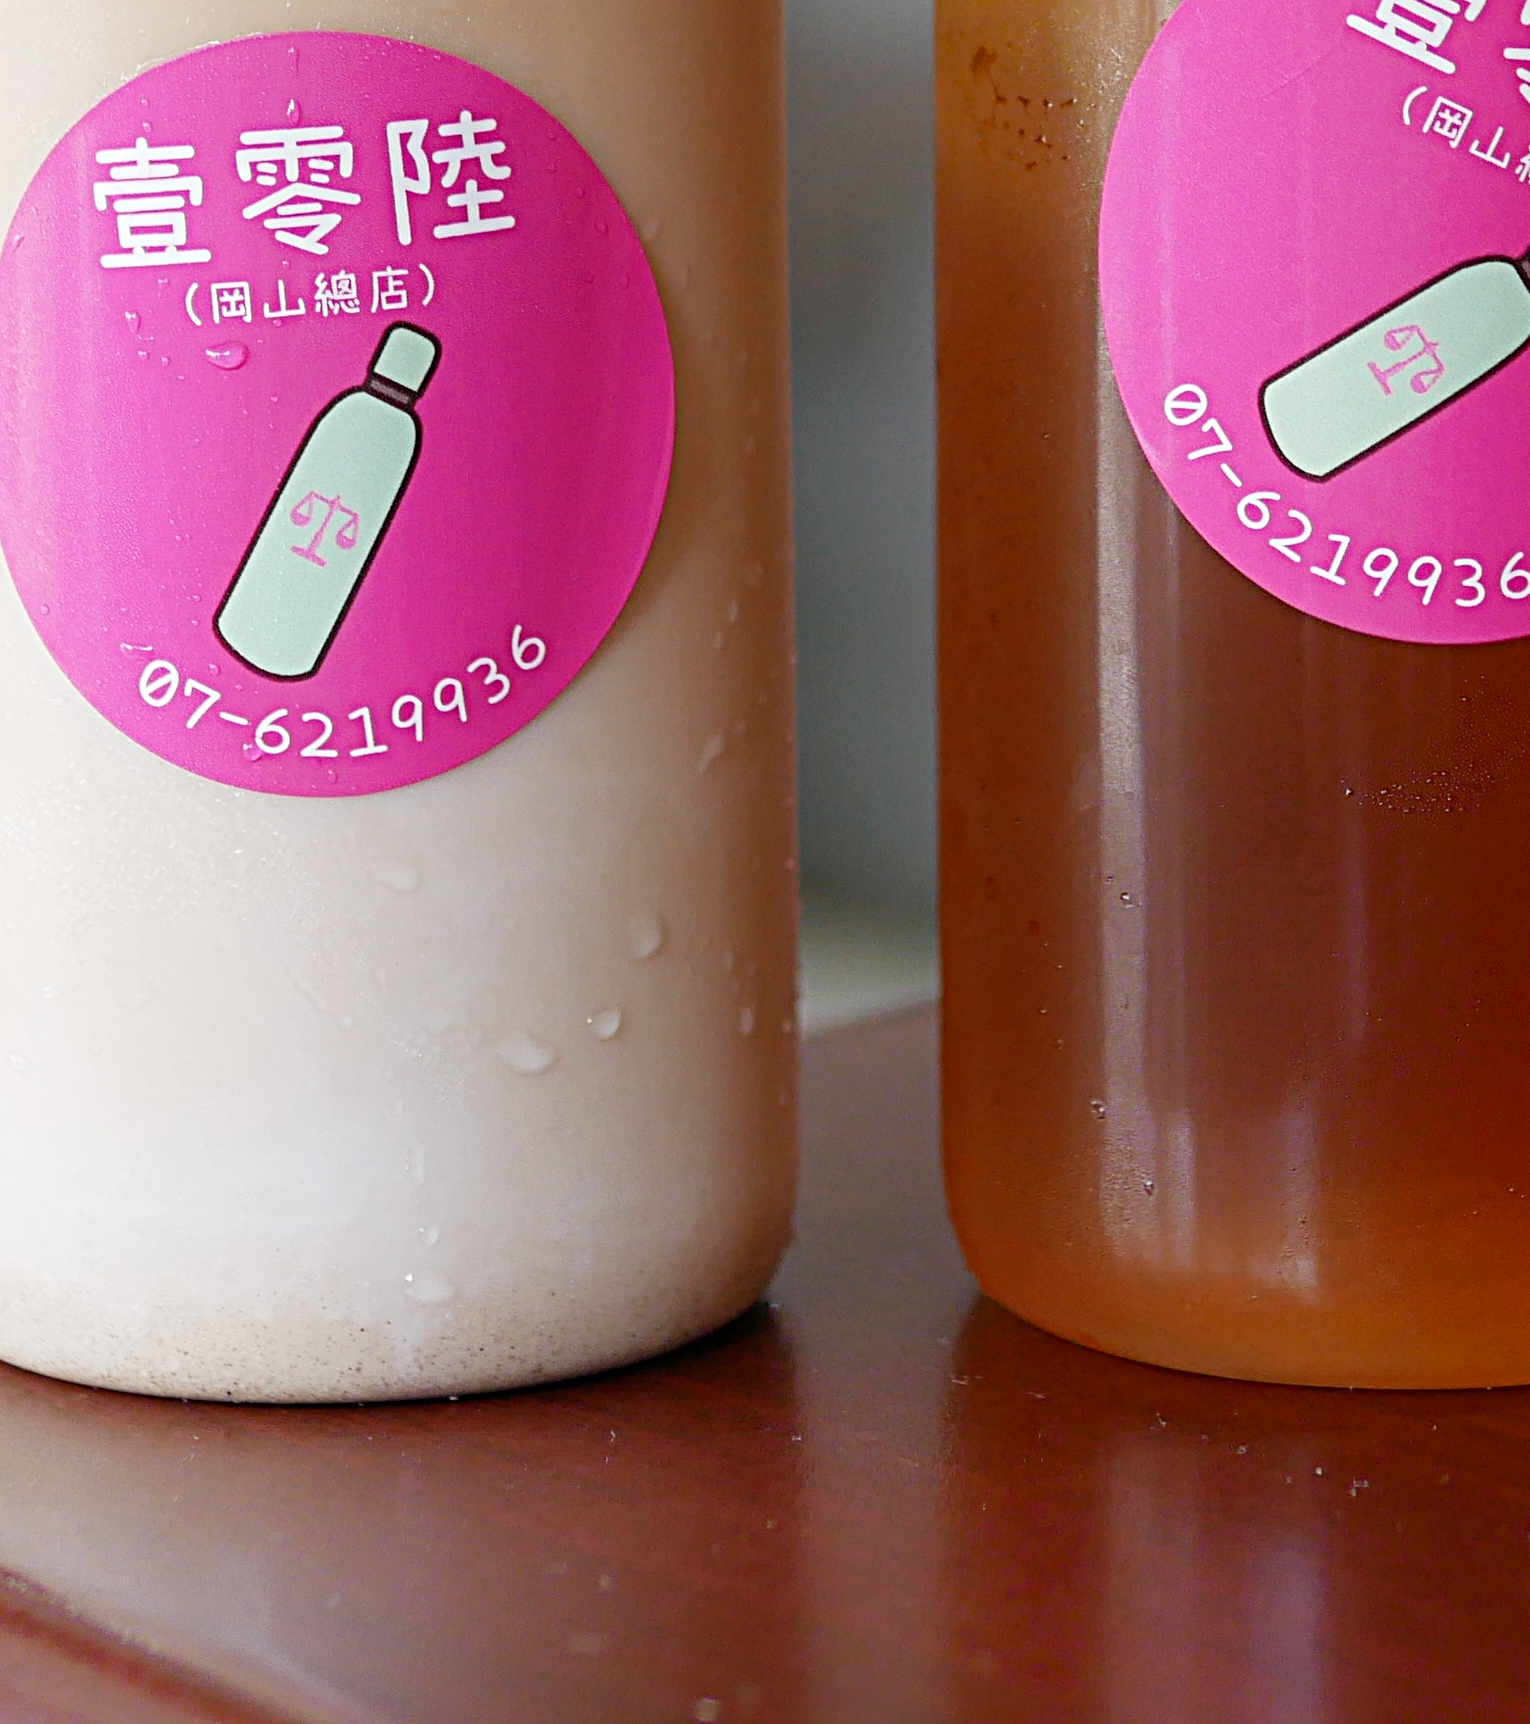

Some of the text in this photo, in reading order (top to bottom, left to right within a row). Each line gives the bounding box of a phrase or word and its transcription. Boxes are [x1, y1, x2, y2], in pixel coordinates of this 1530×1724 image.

[92, 110, 516, 269] 壹零陸
[183, 263, 437, 327] (岡山總店)
[139, 624, 547, 759] 07-6219936
